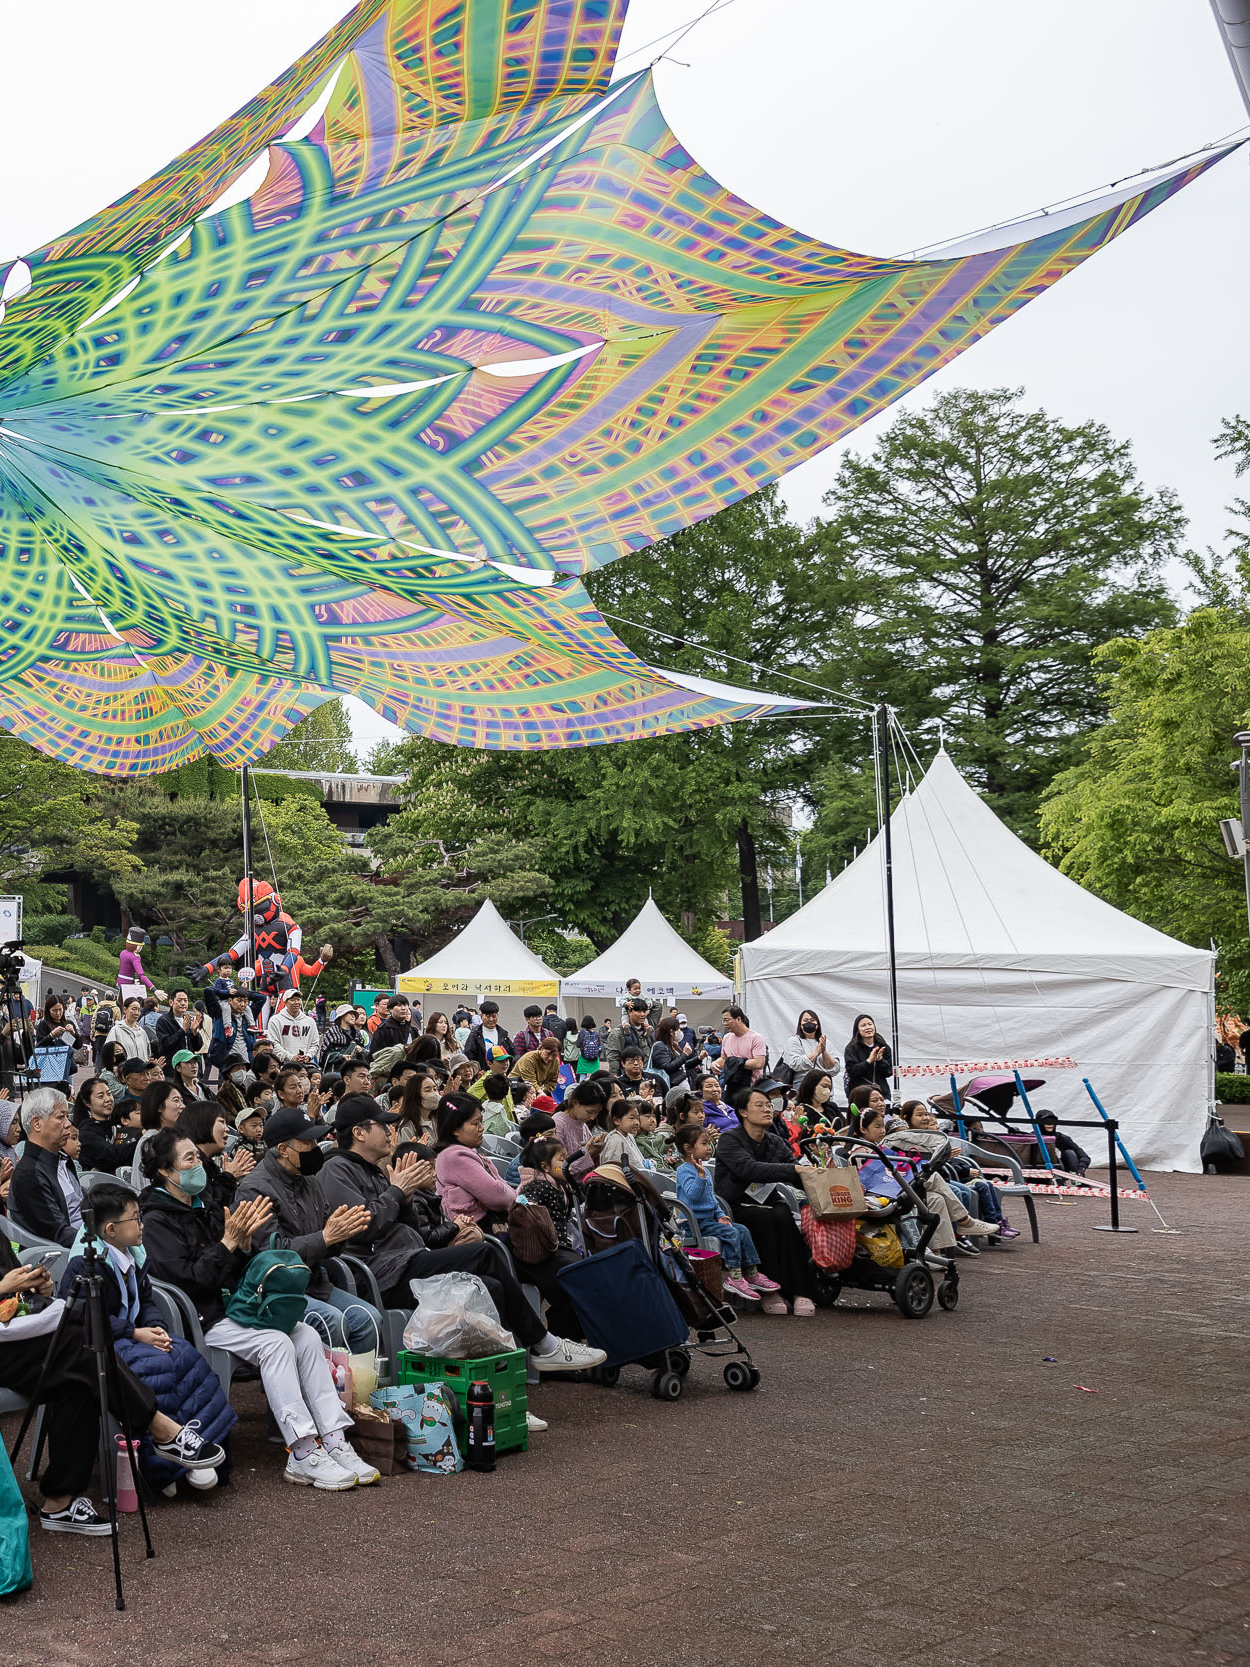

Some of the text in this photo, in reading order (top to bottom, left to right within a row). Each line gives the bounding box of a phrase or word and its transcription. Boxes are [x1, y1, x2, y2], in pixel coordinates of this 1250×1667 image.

[475, 983, 511, 993] 낙서하러
[647, 986, 674, 995] 에코백
[495, 1400, 512, 1409] TSINGTAO
